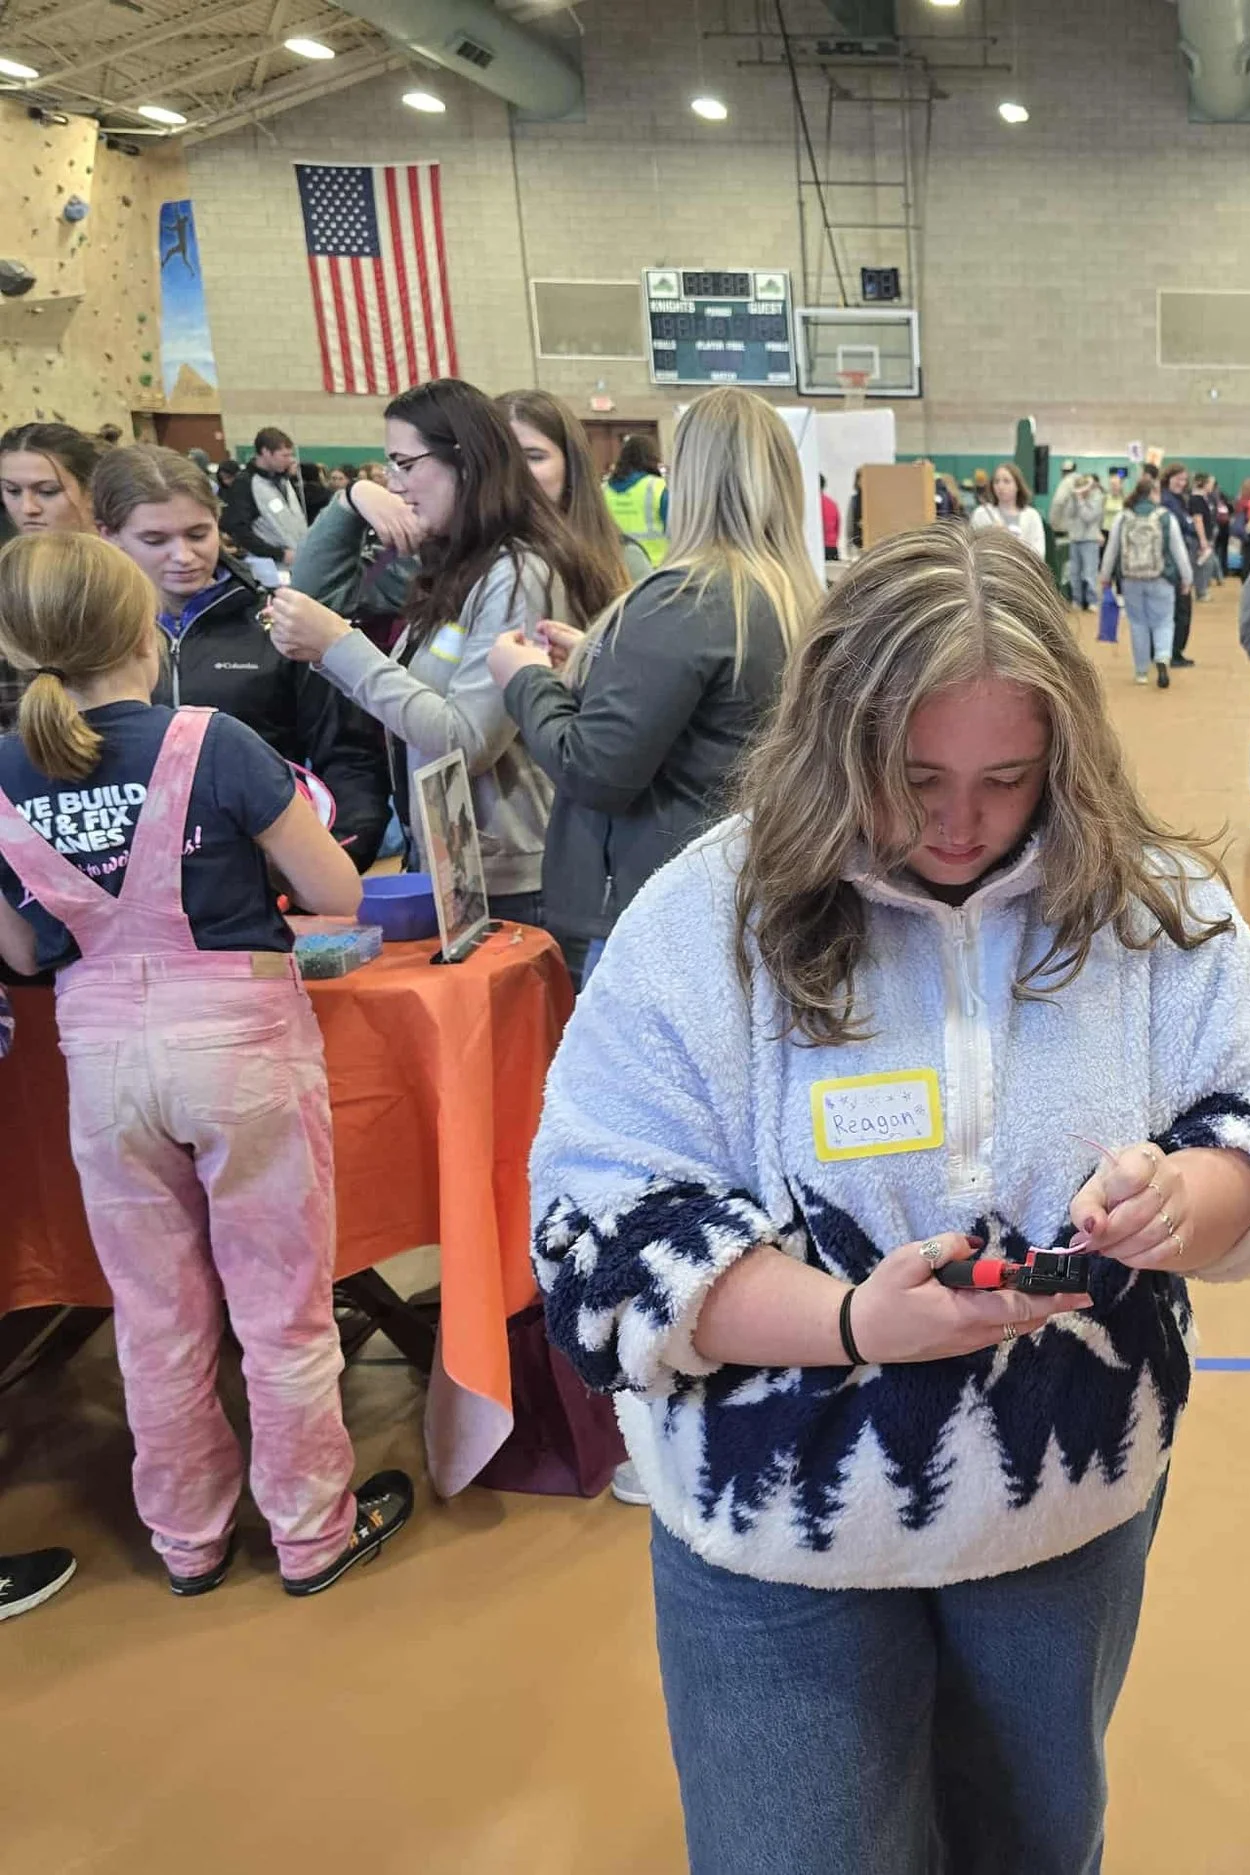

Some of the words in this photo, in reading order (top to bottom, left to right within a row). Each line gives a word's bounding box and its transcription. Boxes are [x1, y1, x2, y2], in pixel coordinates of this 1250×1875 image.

[58, 783, 147, 815] BUILD
[55, 815, 79, 836] &
[83, 805, 134, 832] FIX
[55, 828, 126, 855] ANES
[832, 1110, 916, 1136] Reagan
